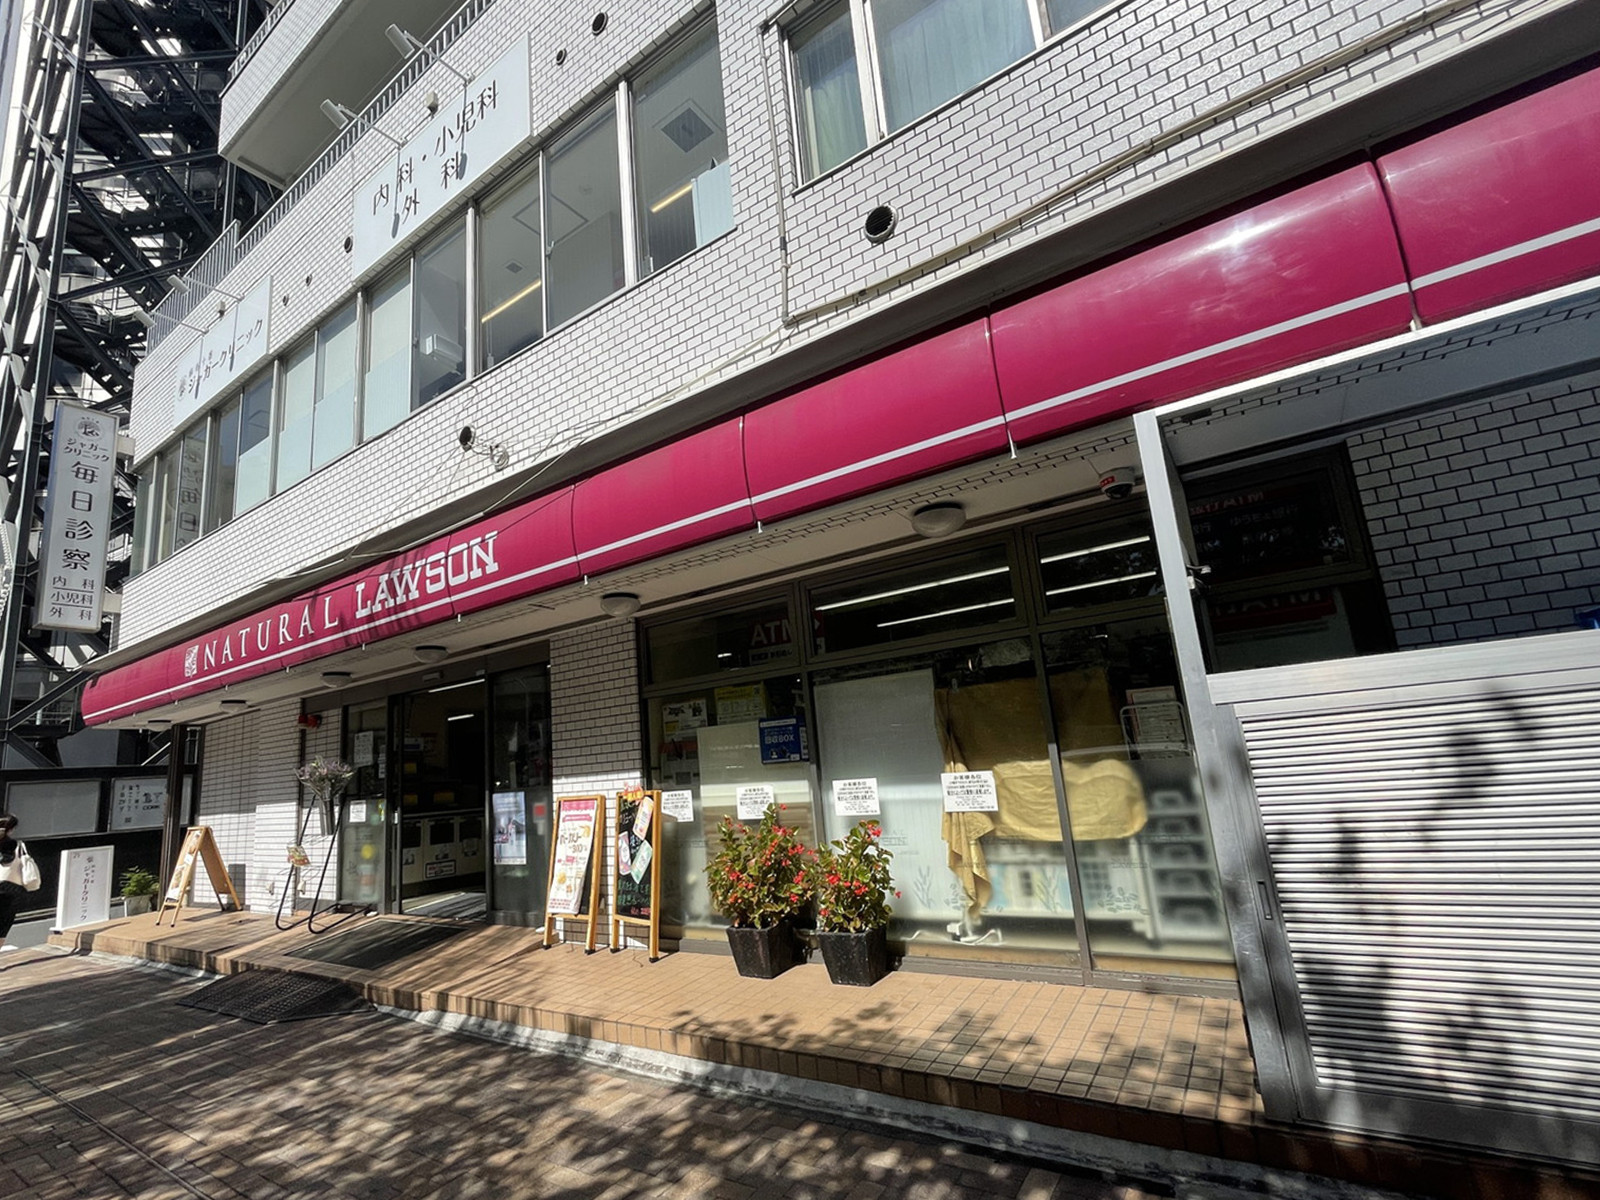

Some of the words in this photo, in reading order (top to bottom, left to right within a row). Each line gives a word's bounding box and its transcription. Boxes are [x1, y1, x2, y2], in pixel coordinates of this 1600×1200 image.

[373, 80, 498, 216] 内科・小児科
[63, 445, 109, 462] クリニック
[67, 437, 108, 452] ジャガー
[62, 461, 99, 571] 毎日診察
[51, 591, 93, 605] 小児科
[203, 596, 339, 671] NATURAL
[355, 531, 498, 618] LAWSON
